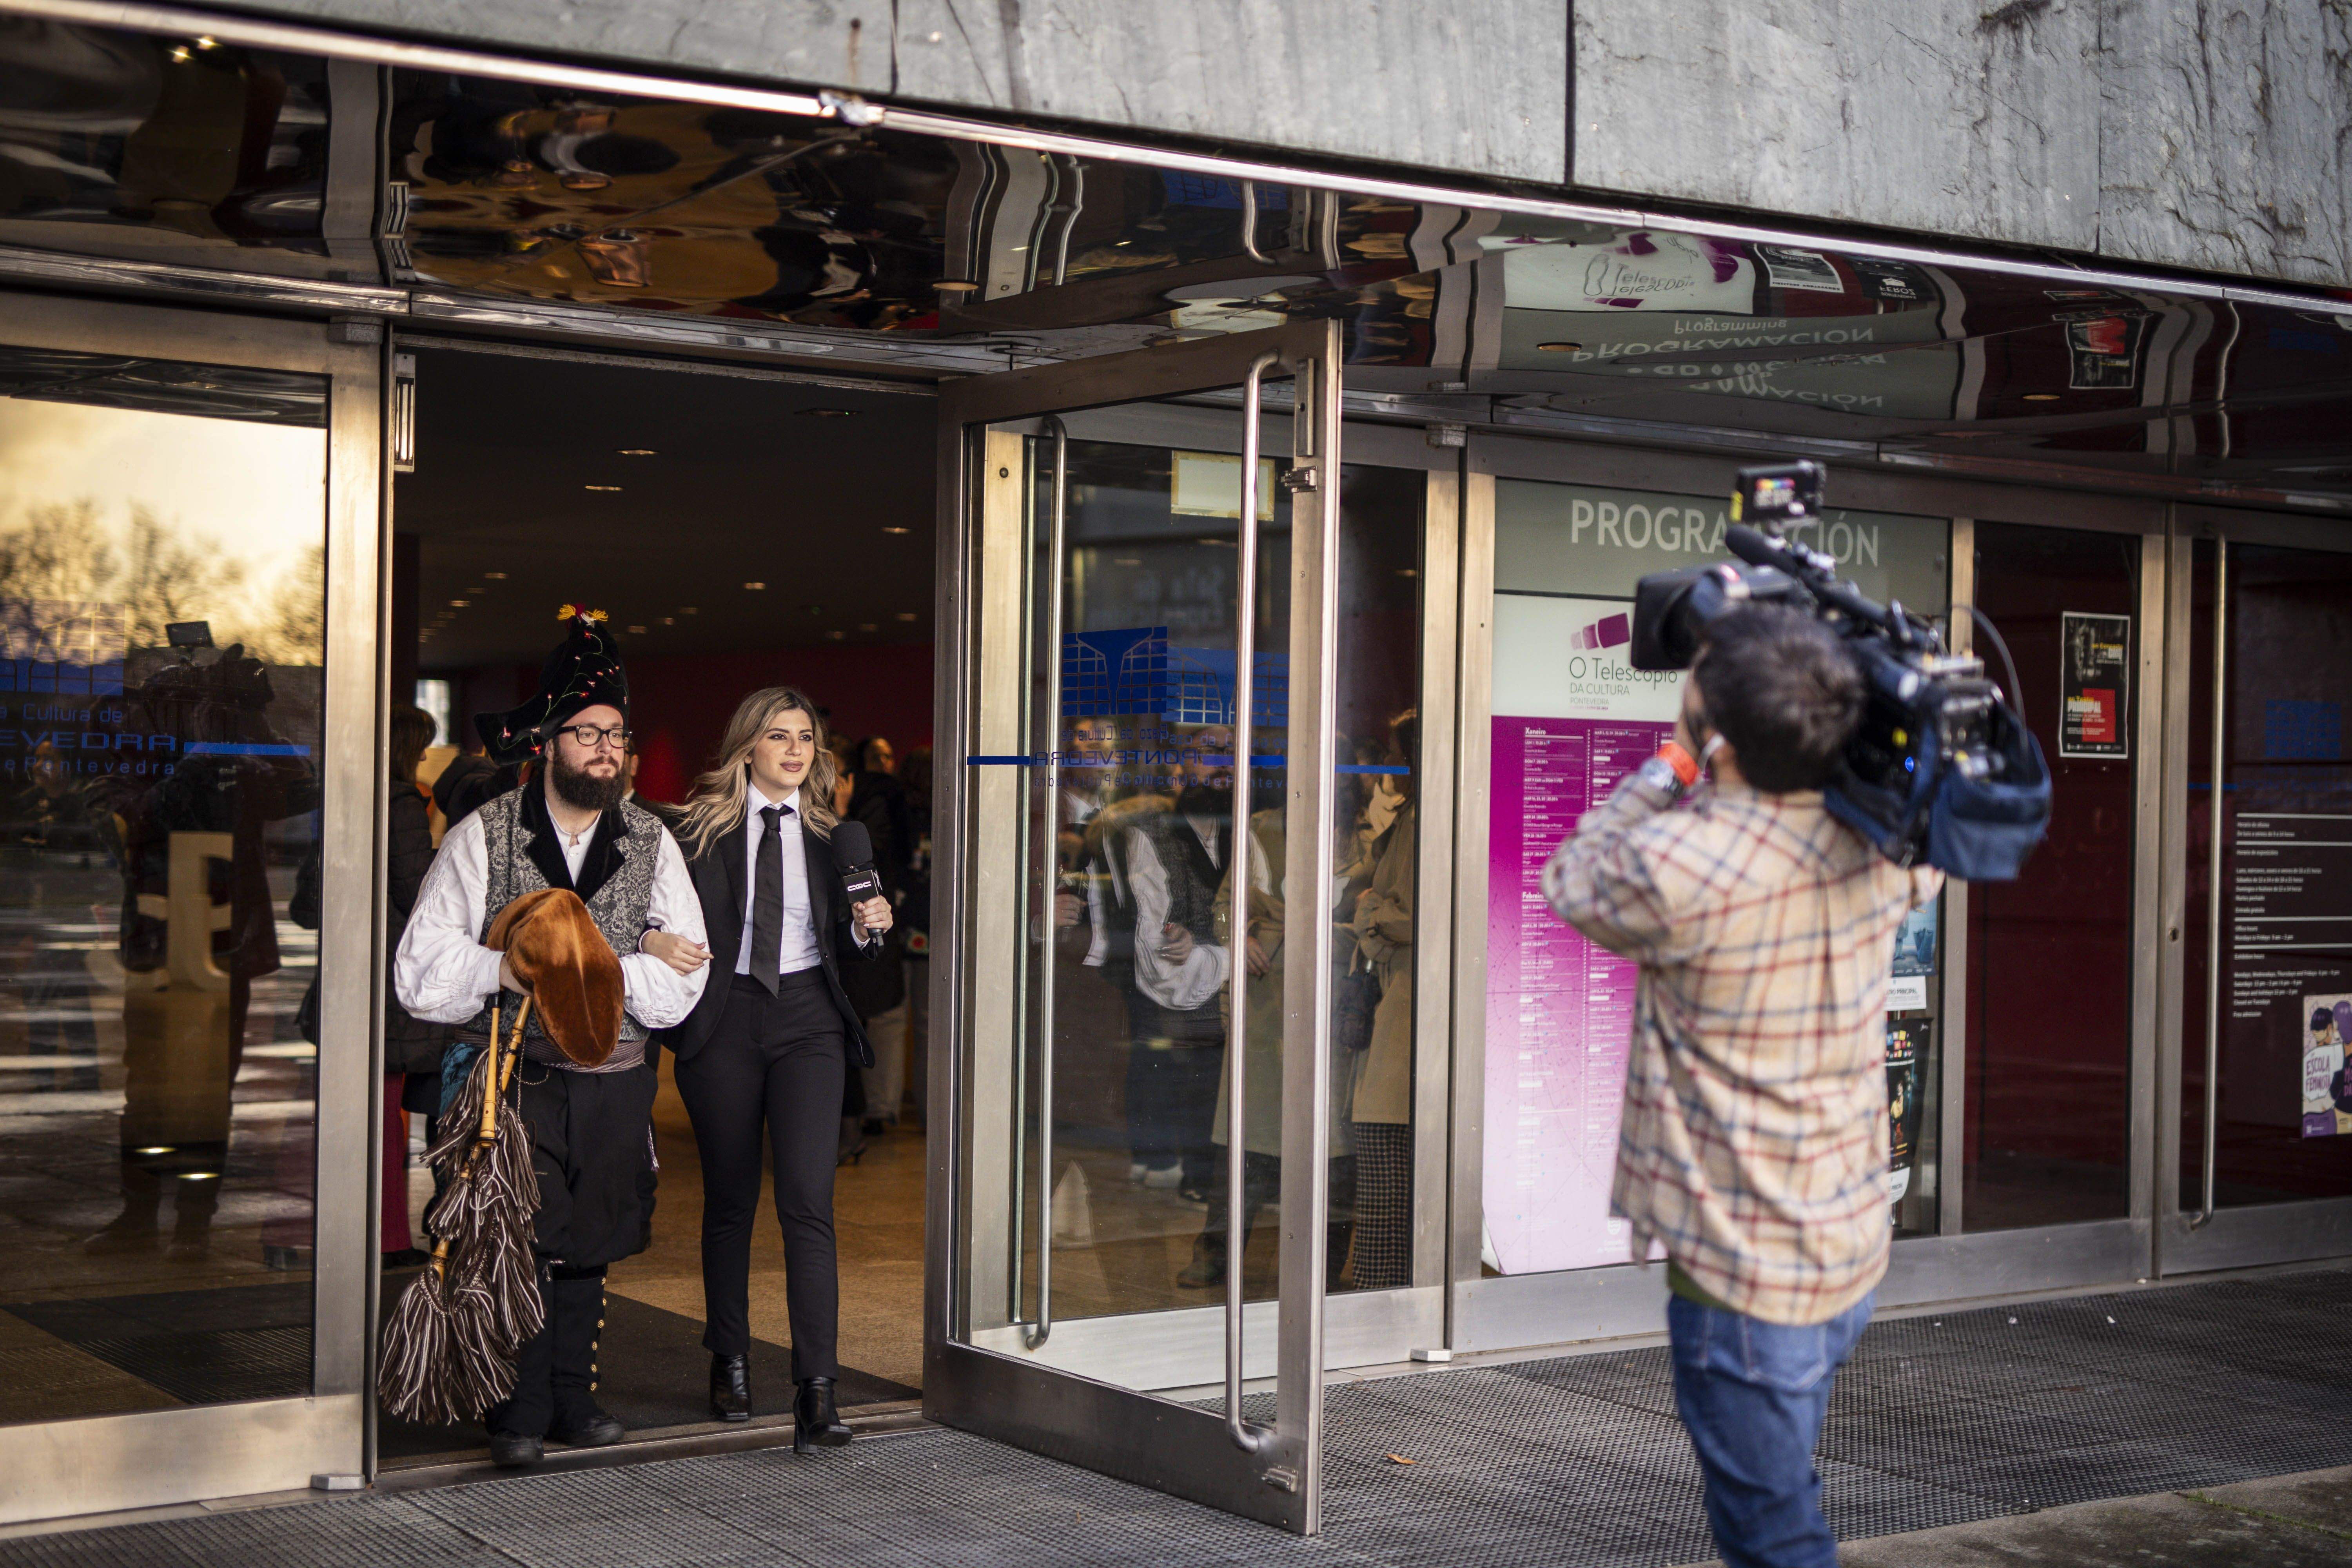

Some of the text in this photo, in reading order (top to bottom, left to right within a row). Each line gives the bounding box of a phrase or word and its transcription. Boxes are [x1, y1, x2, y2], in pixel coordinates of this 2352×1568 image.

[1572, 499, 1878, 569] PROGRACIÓN
[1570, 657, 1677, 690] O Telescopio
[1570, 682, 1630, 695] DA CULTURA
[1570, 697, 1610, 705] PONTEVEDRA
[23, 703, 91, 722] Cultura
[100, 706, 123, 723] de
[0, 730, 176, 751] EVEDRA
[1525, 727, 1546, 735] Xaneiro
[24, 756, 175, 775] Pontevedra
[847, 881, 872, 892] CQC
[2306, 1054, 2330, 1076] ESCOLA
